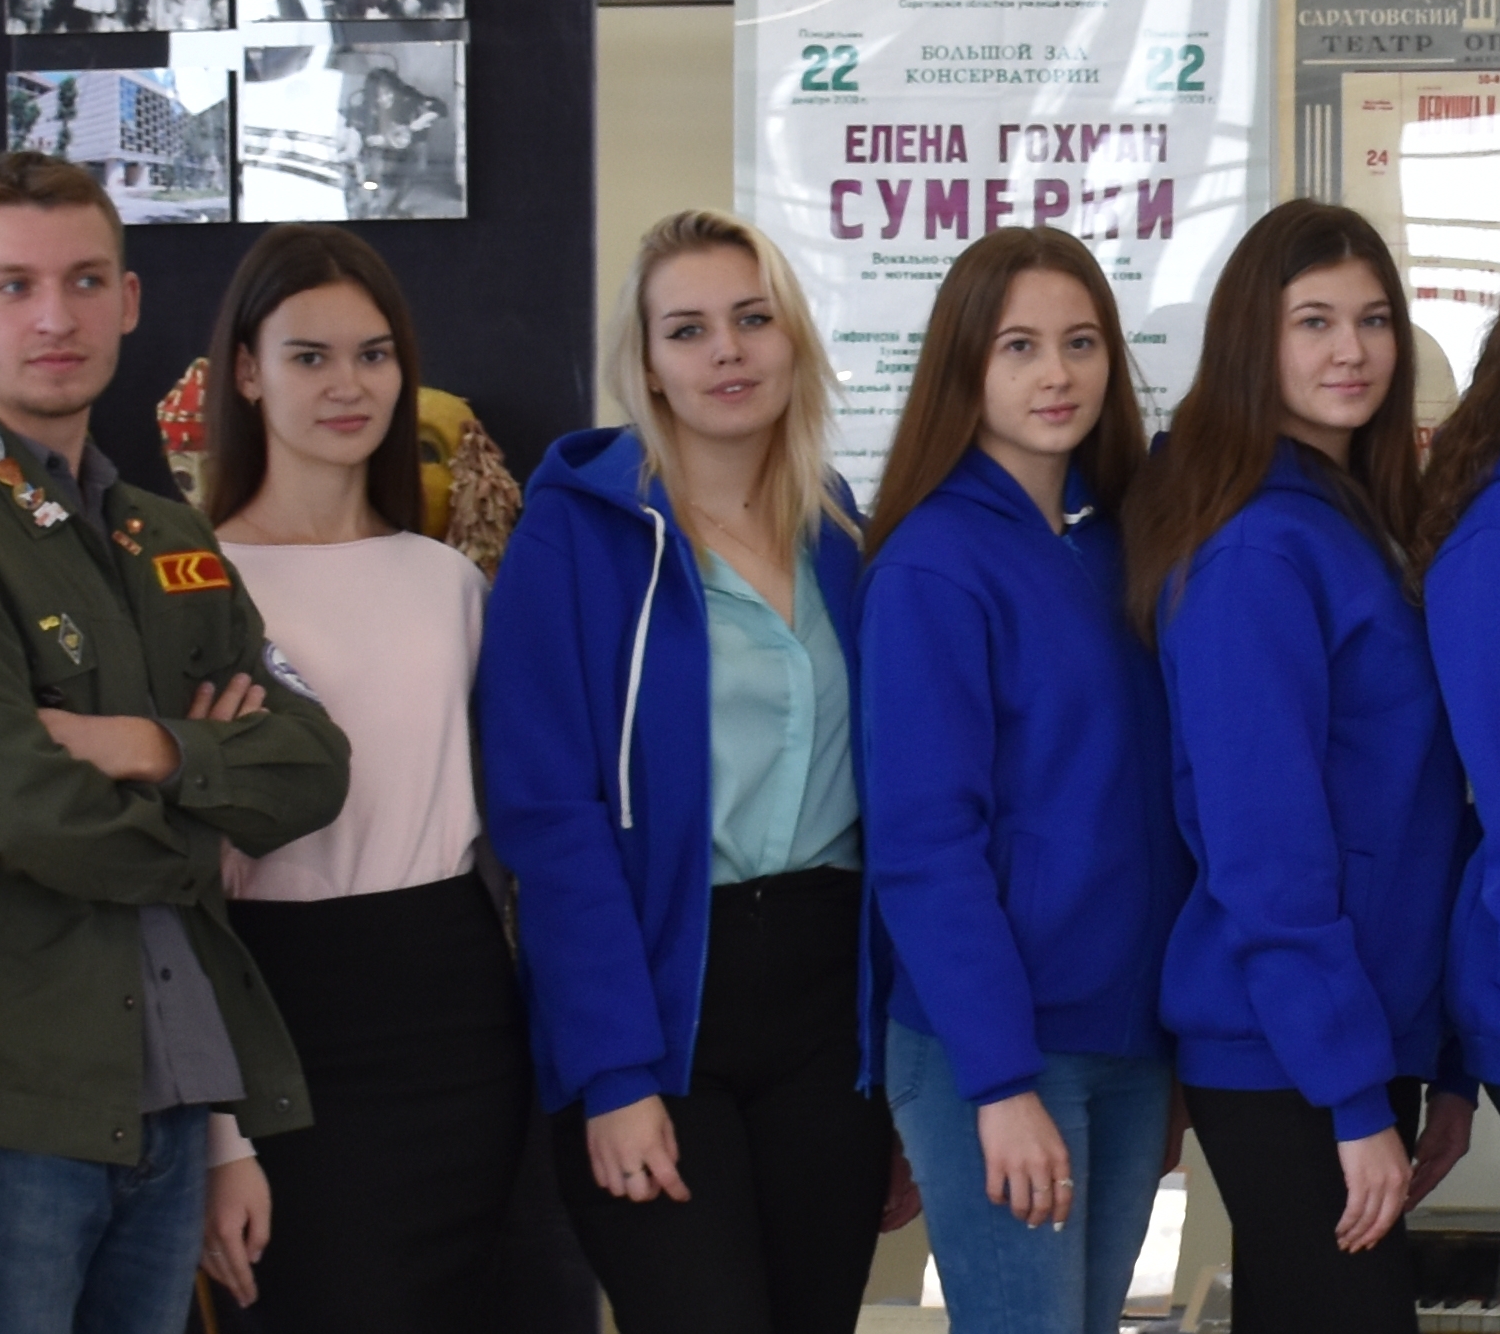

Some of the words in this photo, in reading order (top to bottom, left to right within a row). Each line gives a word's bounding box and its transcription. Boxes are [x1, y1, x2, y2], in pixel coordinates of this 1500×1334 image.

[1298, 5, 1458, 27] САРАТОВСКИЙ
[921, 43, 1032, 62] БОЛЬШОЙ
[1044, 43, 1090, 62] ЗАЛ
[1322, 34, 1434, 54] ТЕАТР
[801, 44, 859, 92] 22
[905, 67, 1100, 85] КОНСЕРВАТОРИИ
[1146, 44, 1206, 92] 22
[845, 124, 968, 164] ЕЛЕНА
[999, 124, 1168, 164] ГОХМАН
[1366, 149, 1389, 167] 24
[830, 178, 1175, 241] СУМЕРКИ
